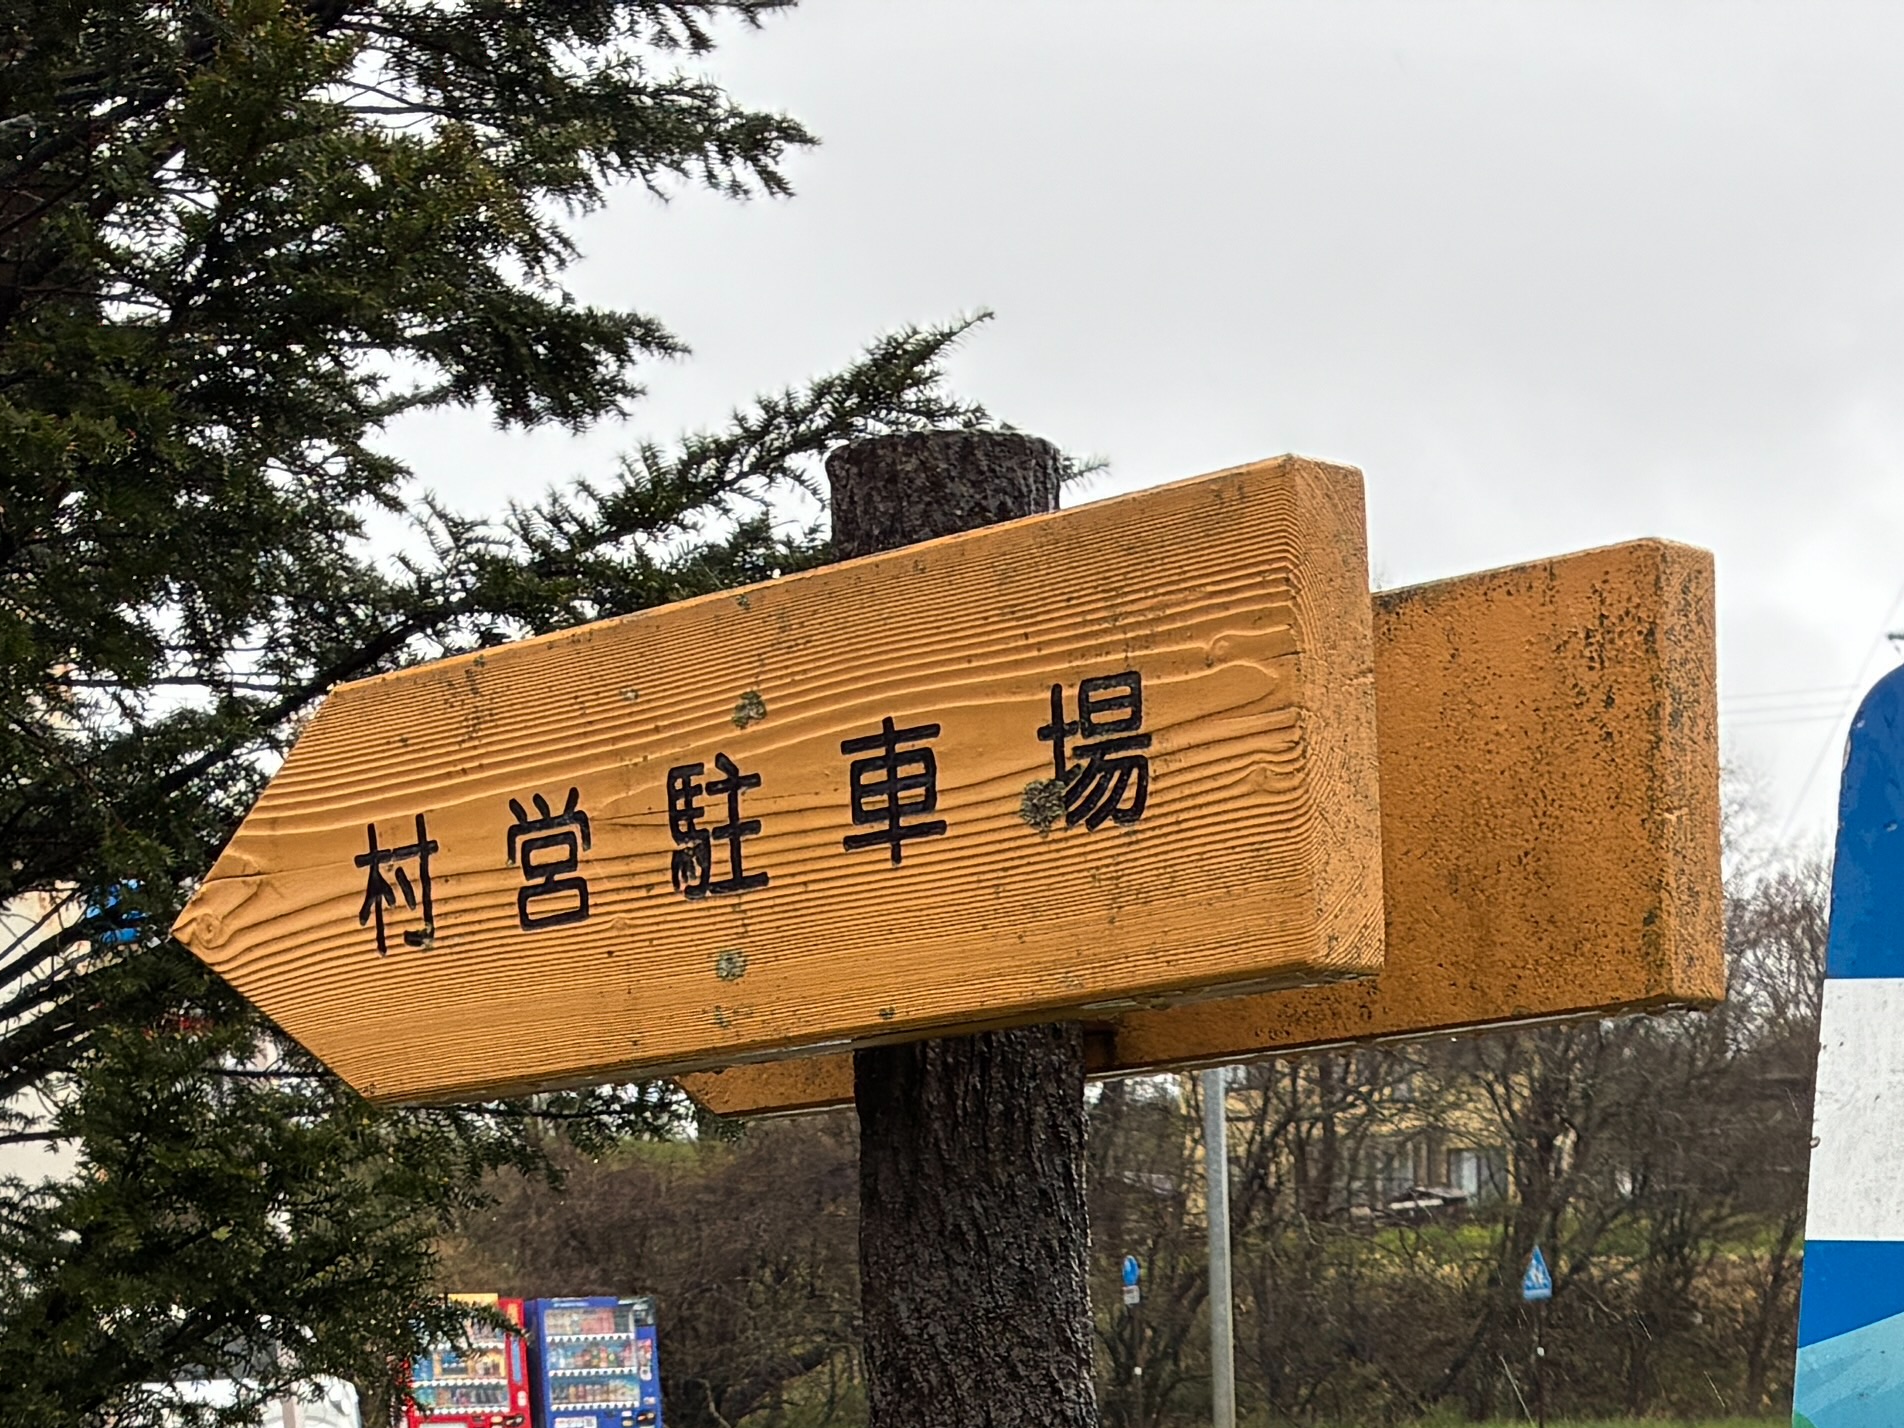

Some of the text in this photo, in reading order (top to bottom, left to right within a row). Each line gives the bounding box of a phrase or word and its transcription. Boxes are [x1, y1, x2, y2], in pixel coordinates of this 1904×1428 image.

[354, 670, 1153, 956] 村営駐車場
